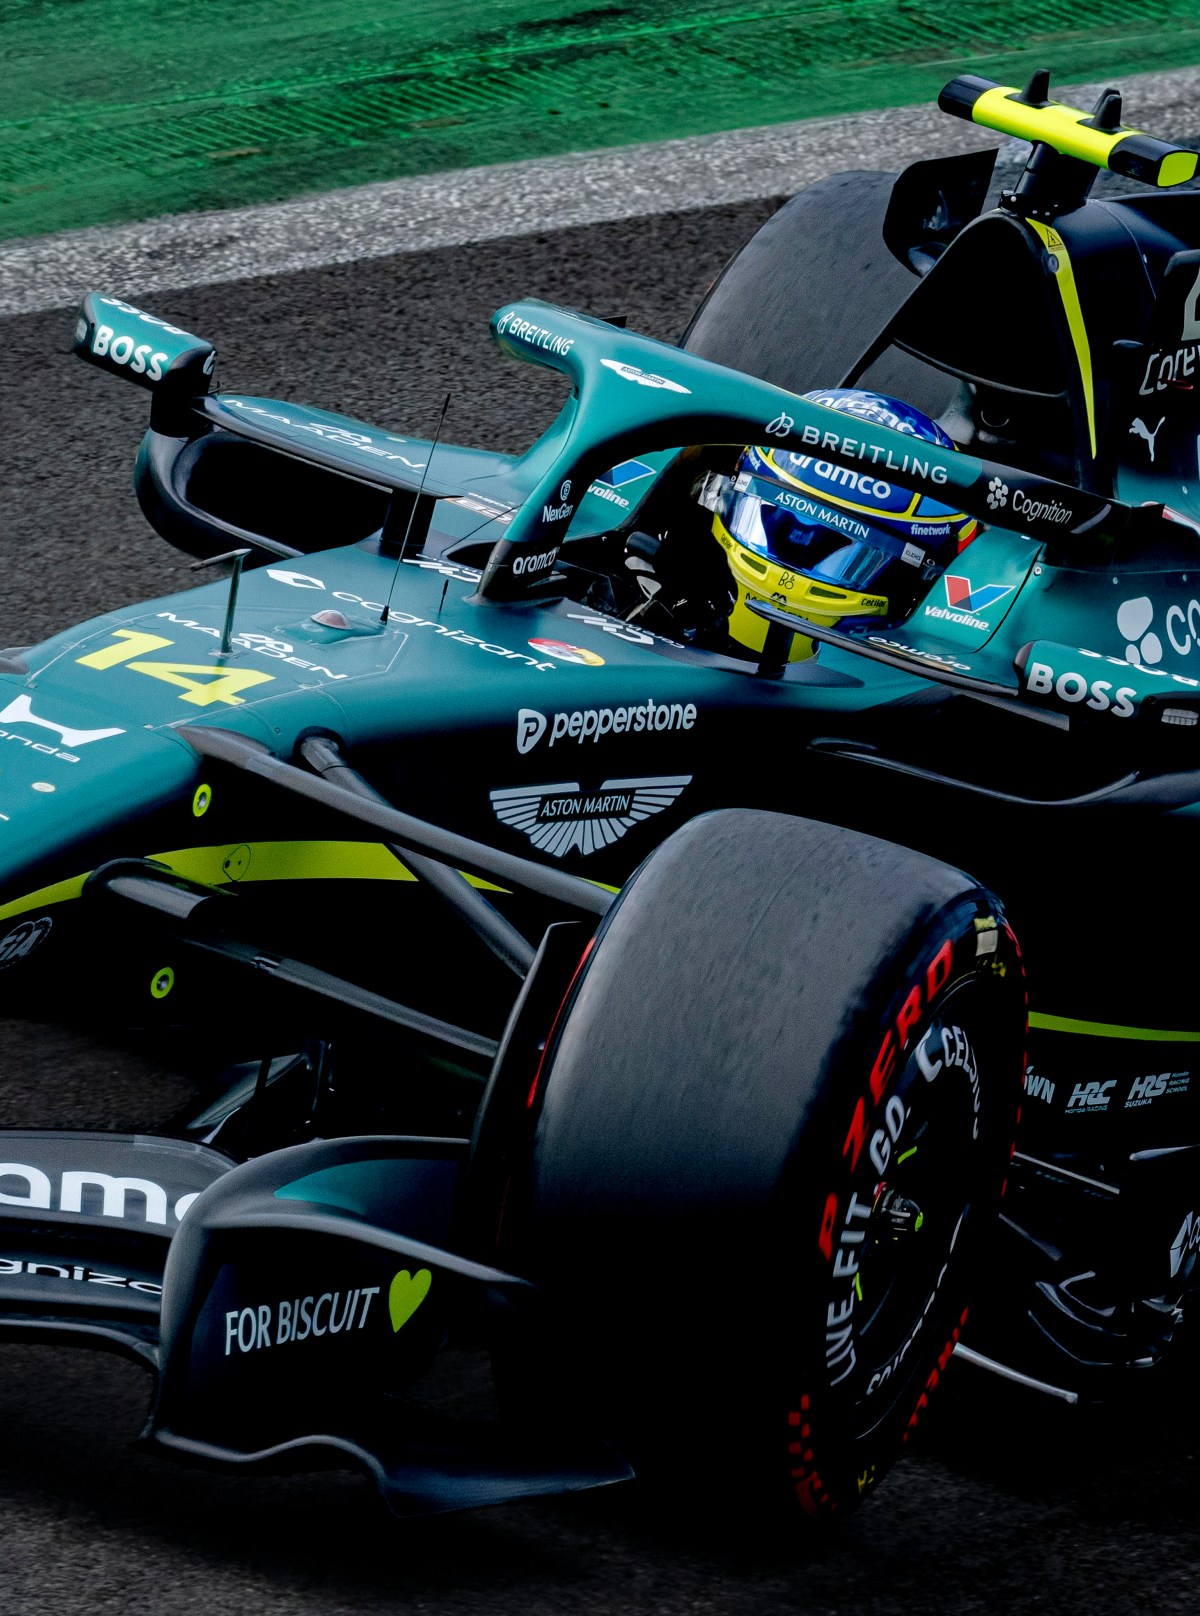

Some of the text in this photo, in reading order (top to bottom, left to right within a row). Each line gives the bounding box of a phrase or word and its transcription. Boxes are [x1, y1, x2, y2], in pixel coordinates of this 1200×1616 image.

[93, 324, 169, 382] BOSS
[509, 317, 575, 357] BREITLING
[1138, 344, 1200, 396] Core
[800, 424, 948, 485] BREITLING
[542, 502, 574, 523] NexGen
[774, 491, 870, 539] ASTON MARTIN
[910, 523, 952, 536] finetwork
[1012, 489, 1073, 525] Cognition
[512, 545, 561, 575] aramco
[332, 591, 557, 673] cognizant
[923, 605, 990, 632] Valvoline
[74, 628, 277, 707] 14
[1026, 661, 1138, 718] BOSS
[548, 699, 698, 747] pepperstone
[540, 794, 631, 818] ASTON MARTIN
[1123, 1098, 1153, 1109] SUZUKA
[224, 1286, 381, 1357] FOR BISCUIT
